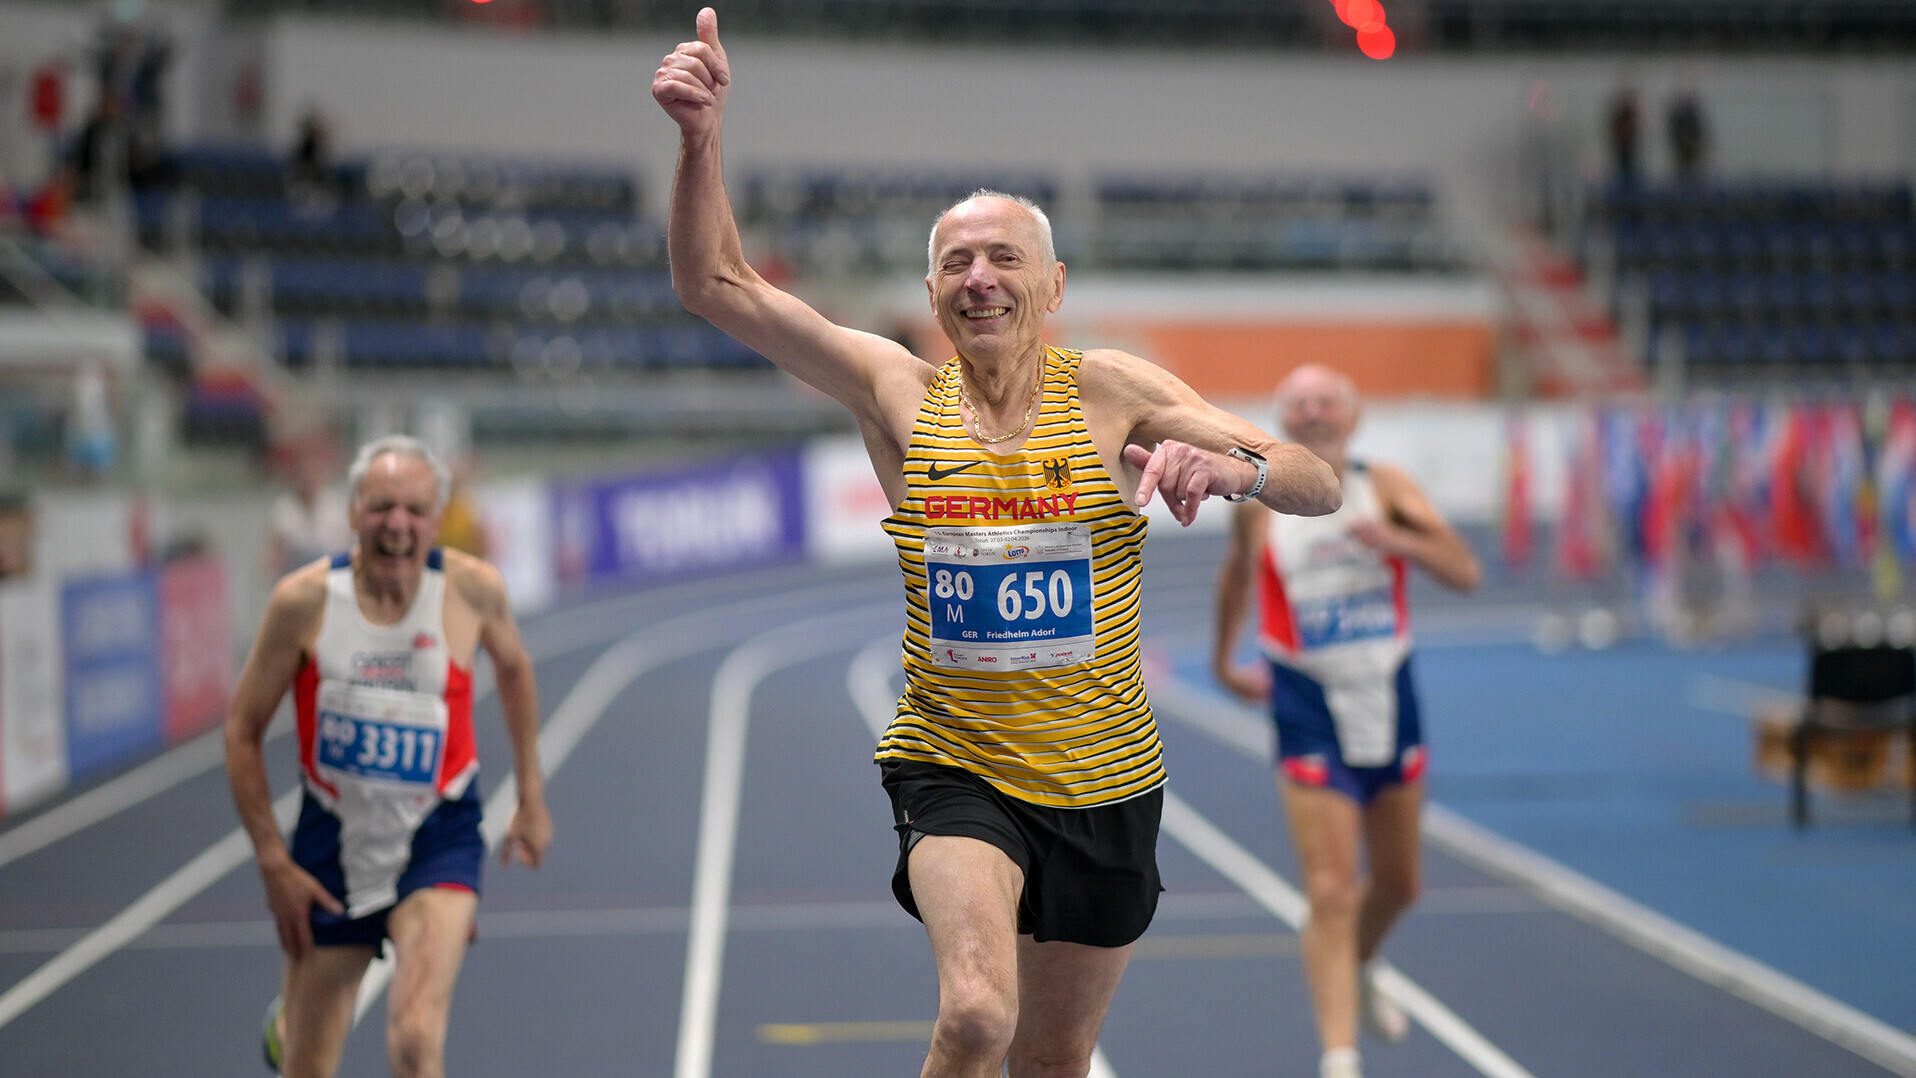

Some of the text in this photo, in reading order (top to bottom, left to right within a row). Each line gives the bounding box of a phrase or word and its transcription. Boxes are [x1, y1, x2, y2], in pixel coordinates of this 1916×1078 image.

[925, 492, 1079, 520] GERMANY
[1007, 548, 1025, 558] LOTTO
[935, 569, 974, 601] 80
[997, 569, 1074, 621] 650
[947, 603, 964, 623] M
[962, 628, 1056, 639] GER Friedhelm Adorf
[355, 723, 436, 774] 3311
